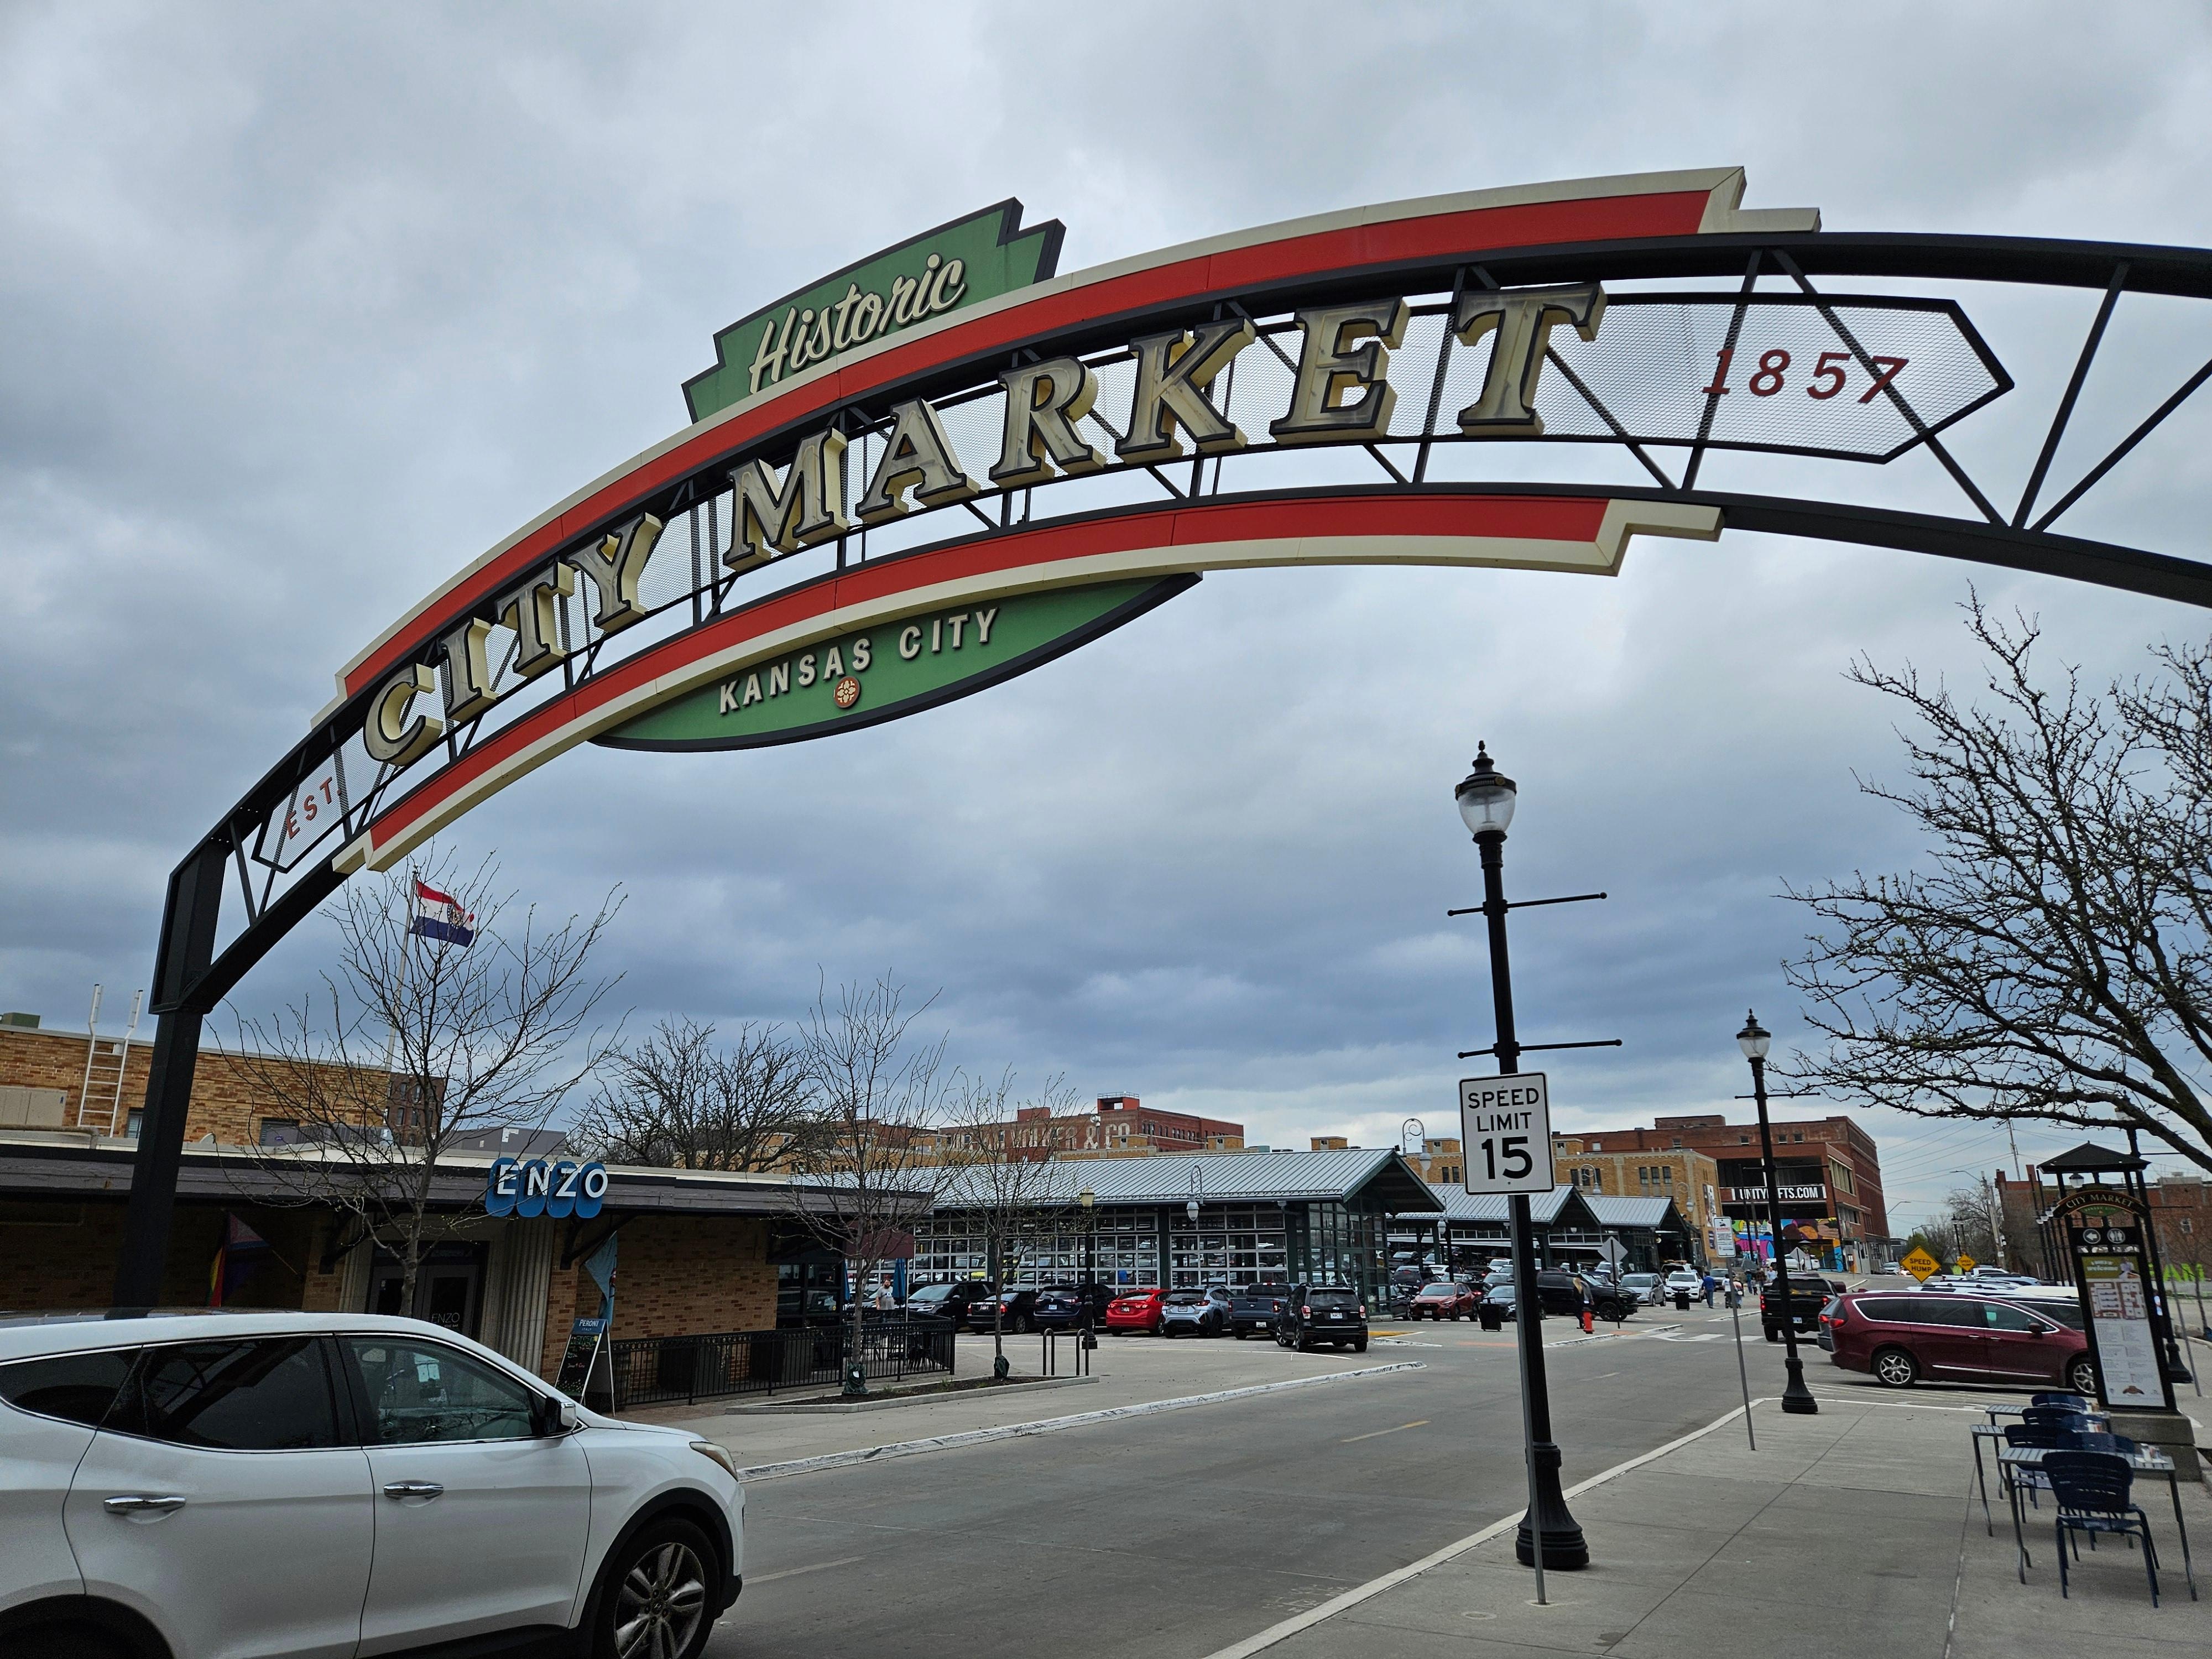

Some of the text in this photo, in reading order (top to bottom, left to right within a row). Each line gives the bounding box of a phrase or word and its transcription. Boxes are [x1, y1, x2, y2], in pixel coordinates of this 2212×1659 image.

[748, 252, 967, 395] Historic
[1702, 348, 1910, 404] 1857
[363, 281, 1608, 768] CITY MARKET
[718, 607, 1000, 715] KANSAS CITY
[286, 776, 342, 839] EST.
[1468, 1087, 1539, 1109] SPEED
[1477, 1112, 1532, 1133] LIMIT
[1481, 1136, 1533, 1180] 15
[497, 1164, 608, 1198] ENZO
[2067, 1193, 2133, 1208] CITY MARKET
[432, 1312, 460, 1323] ENZO
[578, 1319, 599, 1327] PERONI
